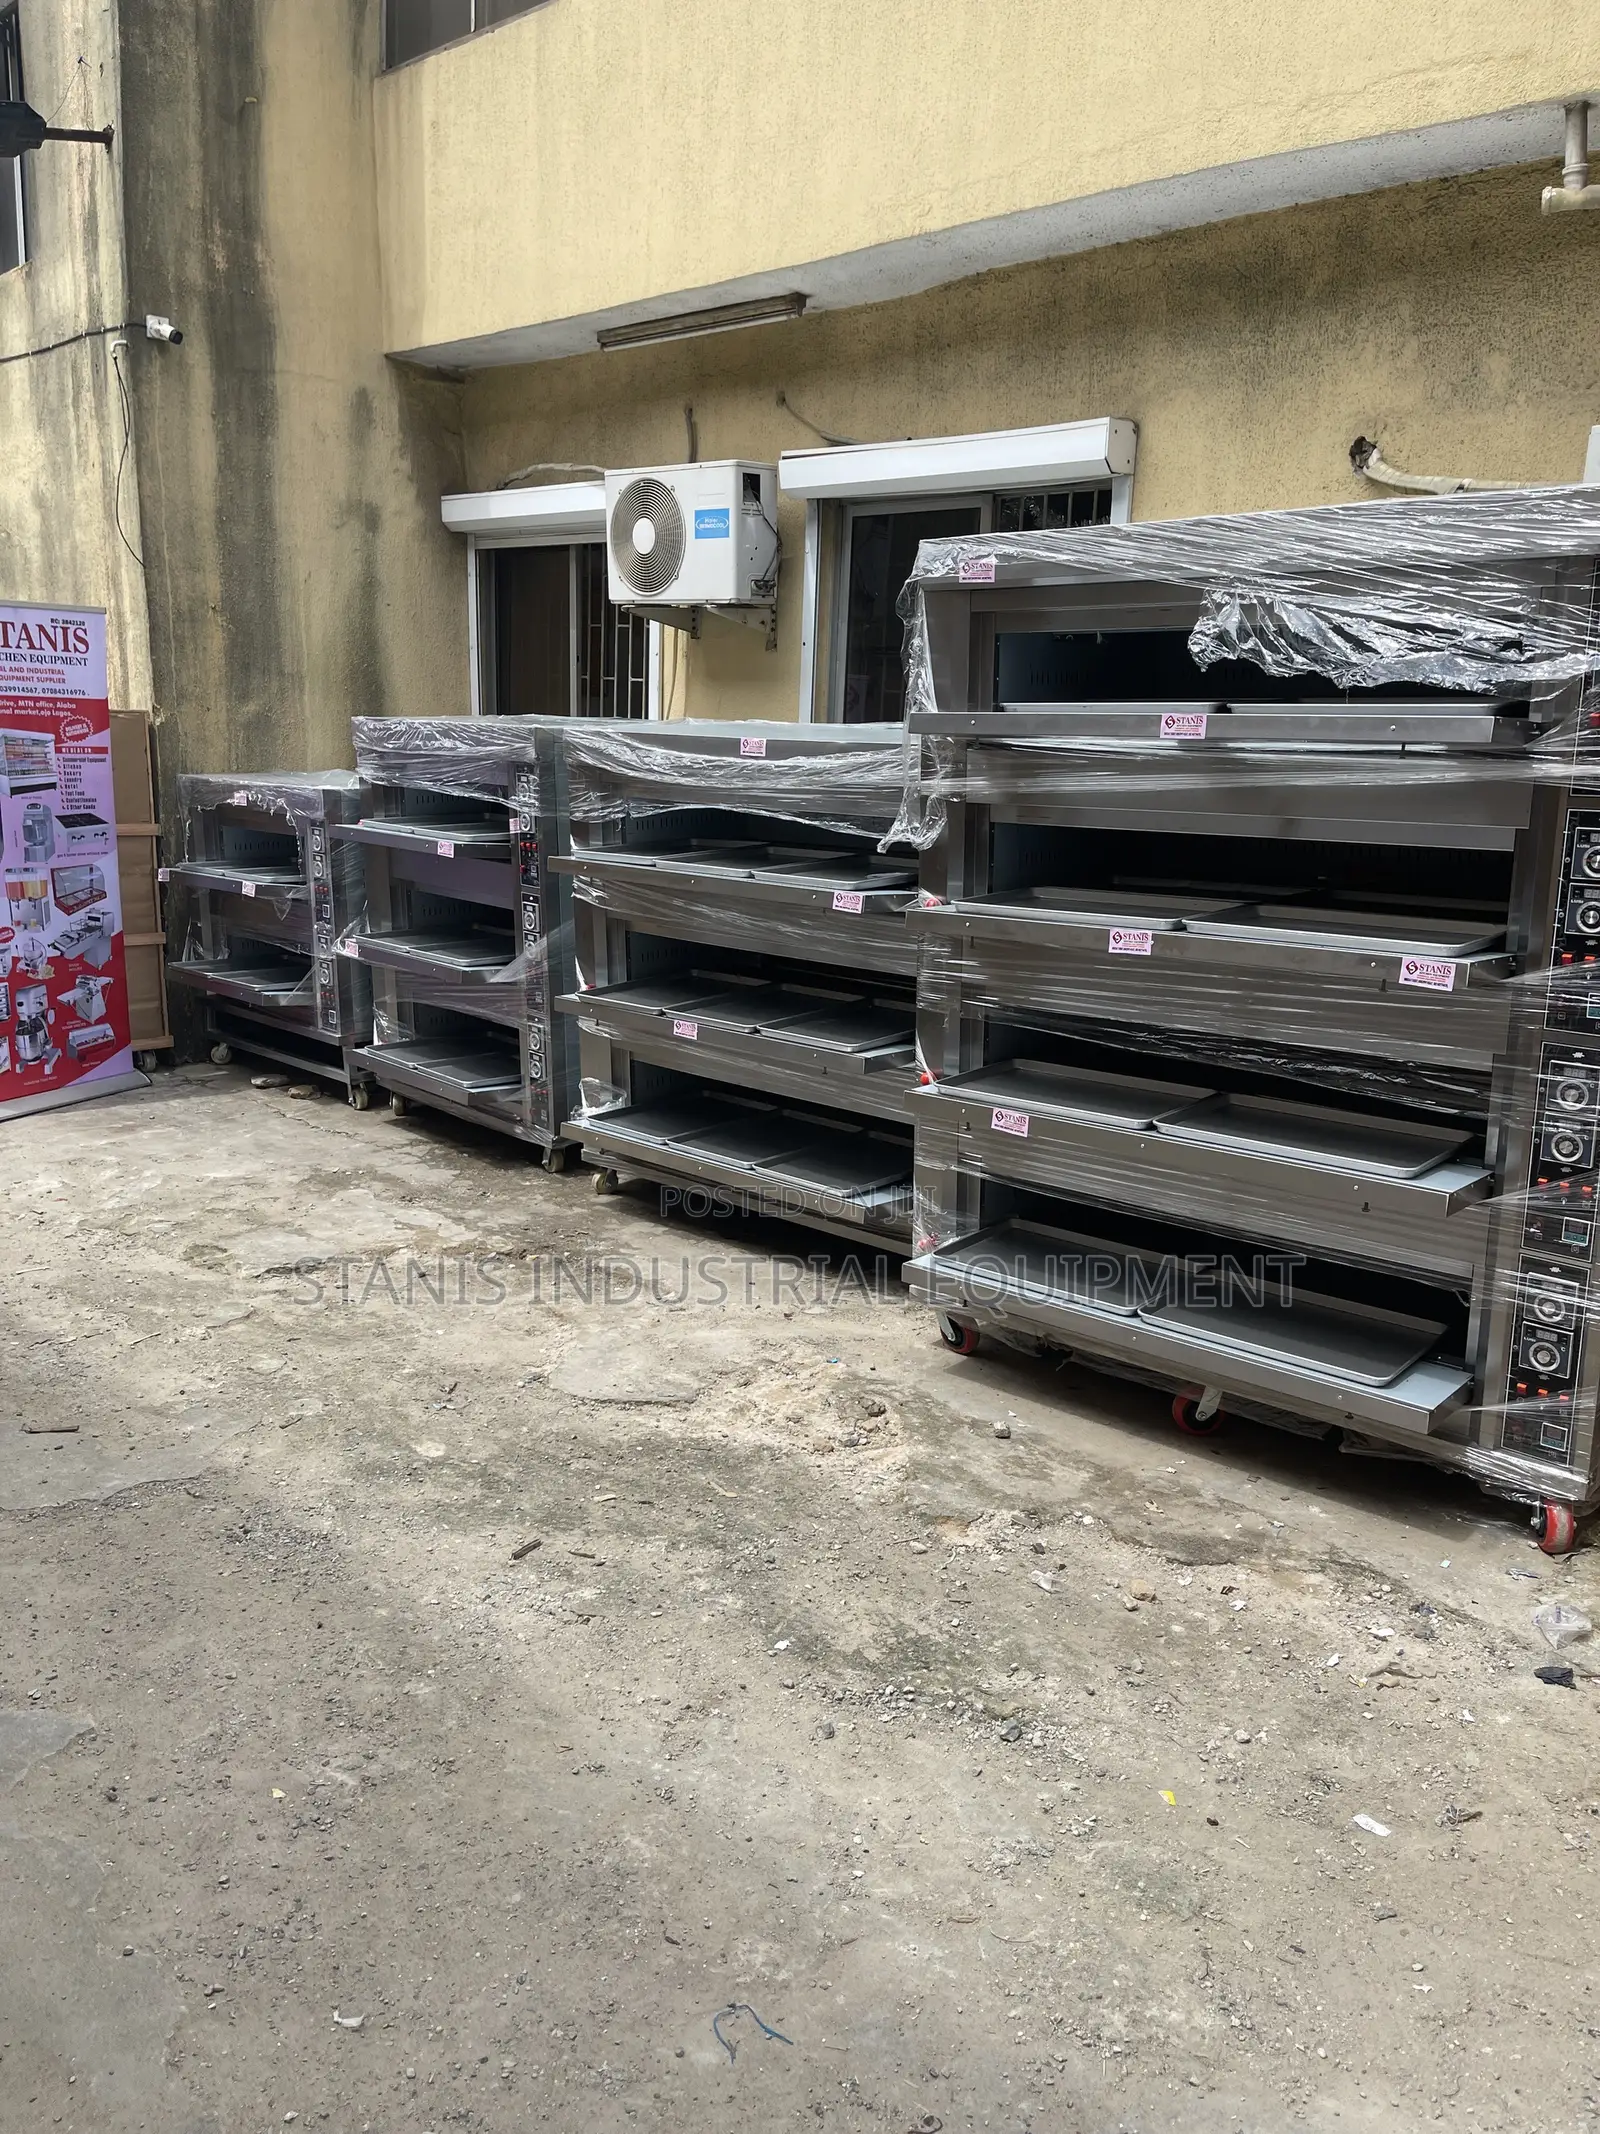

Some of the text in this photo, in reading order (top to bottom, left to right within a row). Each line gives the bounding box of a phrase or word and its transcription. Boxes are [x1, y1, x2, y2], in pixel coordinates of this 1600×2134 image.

[30, 653, 88, 667] EQUIPMENT
[9, 666, 25, 674] AND
[27, 667, 66, 676] INDUSTRIAL
[36, 676, 66, 684] SUPPLIER
[18, 700, 34, 708] MTN
[36, 701, 55, 709] office,
[1176, 716, 1204, 725] STANIS
[1123, 932, 1149, 941] STANIS
[1419, 963, 1452, 975] STANIS
